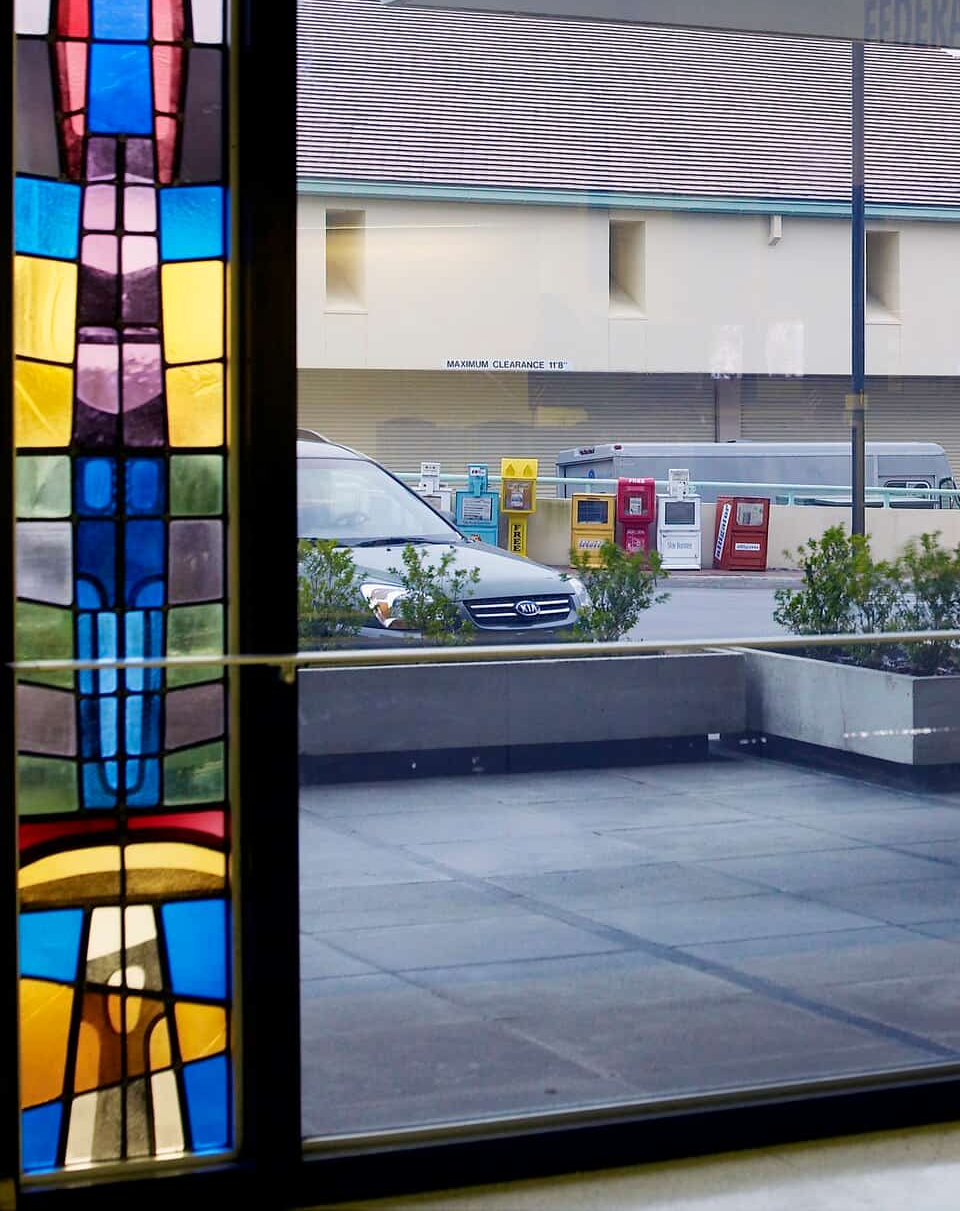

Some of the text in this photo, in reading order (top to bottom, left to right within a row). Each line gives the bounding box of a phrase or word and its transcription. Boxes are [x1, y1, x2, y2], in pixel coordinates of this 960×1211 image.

[446, 360, 489, 368] MAXIMUM
[492, 360, 545, 369] CLEARANCE
[513, 524, 521, 552] FREE
